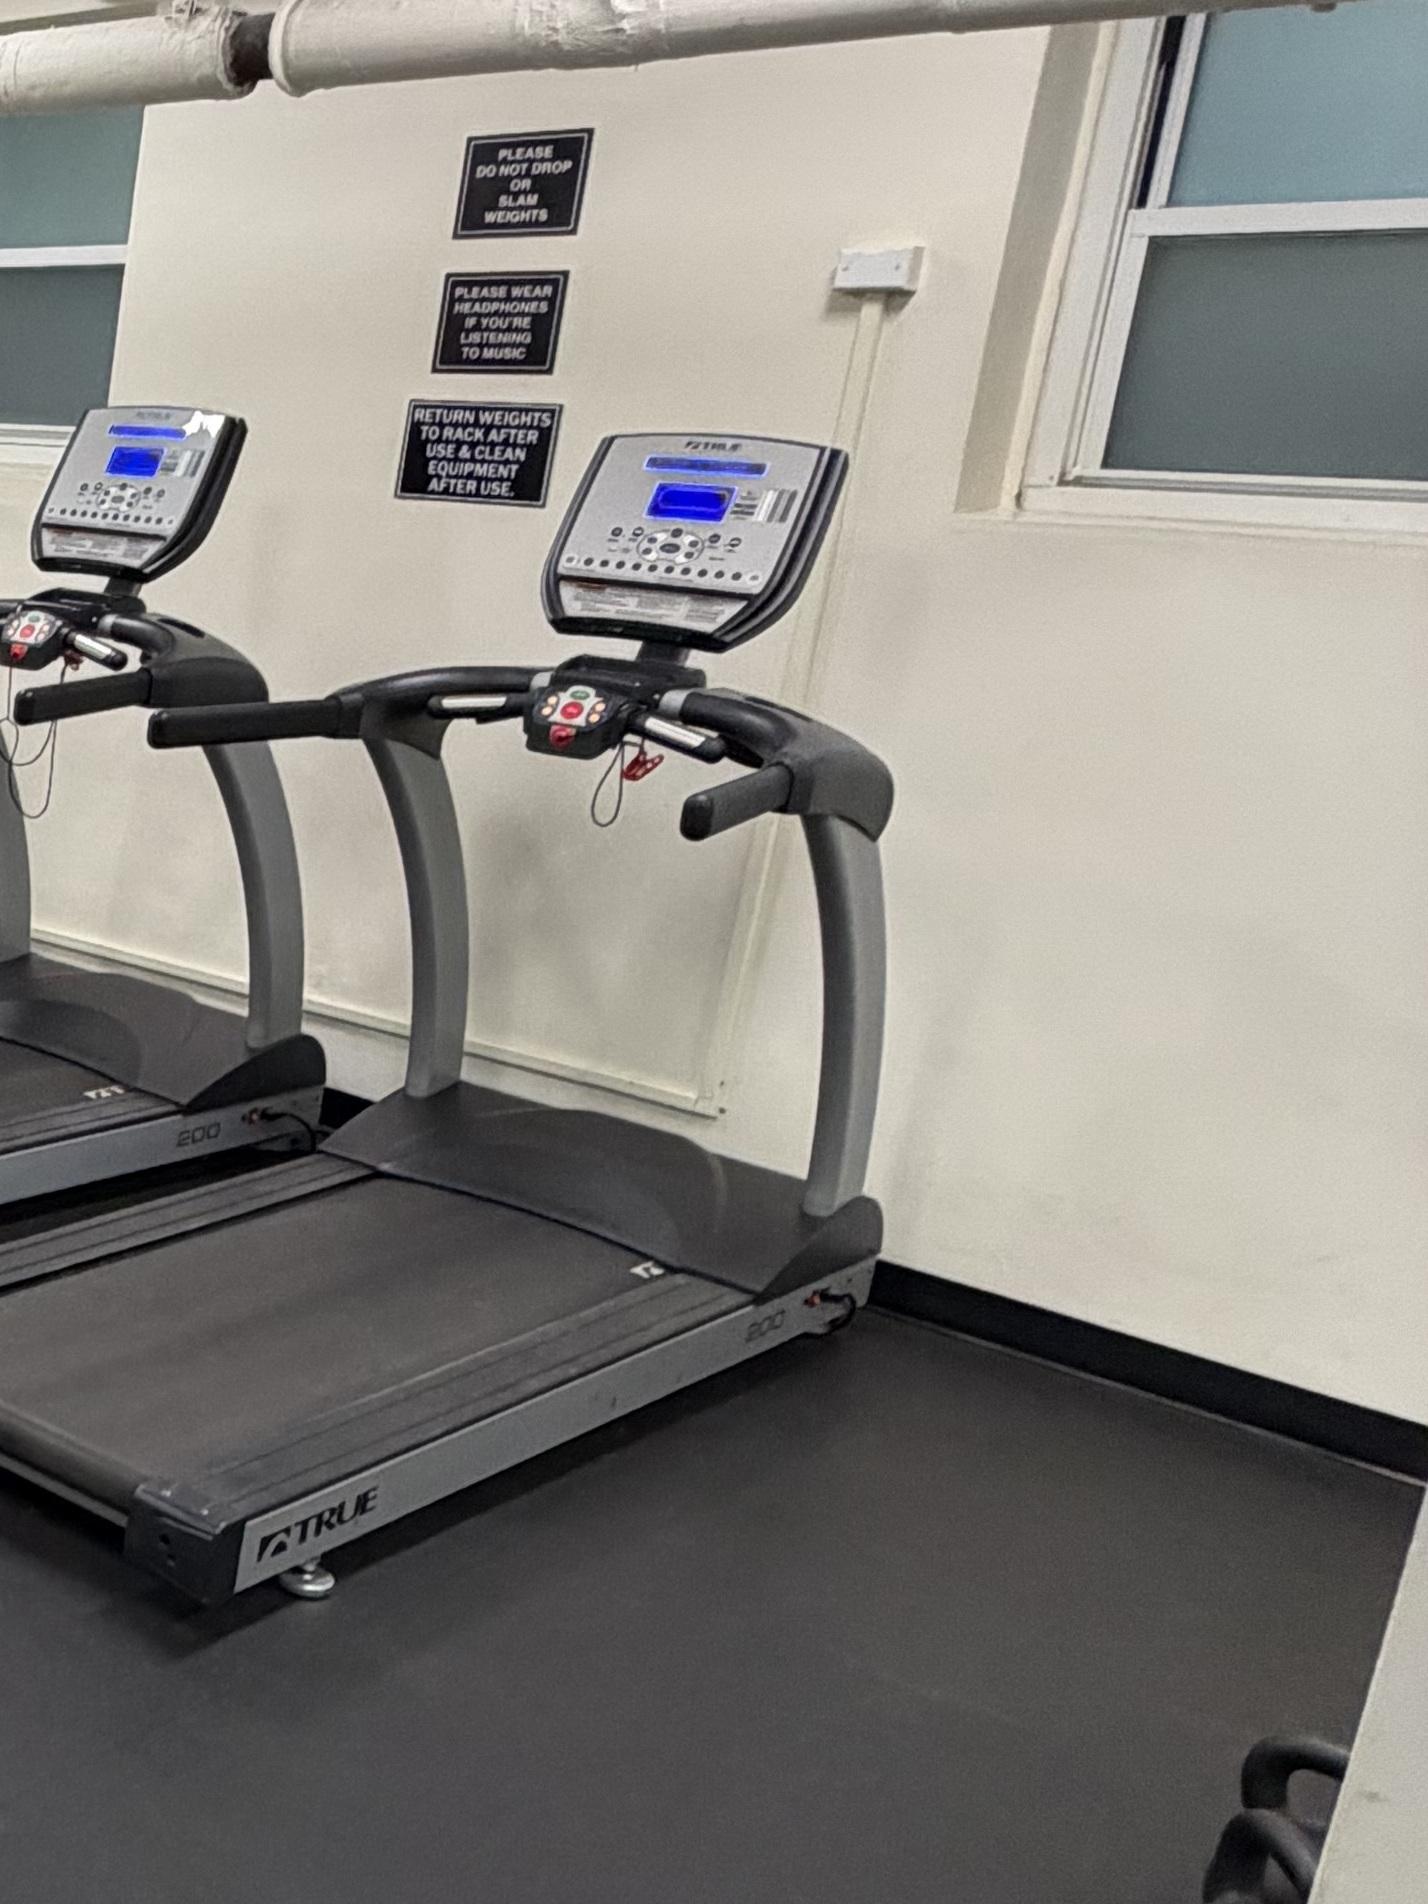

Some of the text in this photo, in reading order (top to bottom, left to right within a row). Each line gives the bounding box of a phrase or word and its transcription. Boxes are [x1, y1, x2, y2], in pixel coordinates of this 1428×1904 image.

[498, 145, 554, 162] PLEASE
[476, 160, 573, 178] DO NOT DROP
[510, 178, 532, 192] OR
[498, 193, 539, 208] SLAM
[484, 208, 548, 224] WEIGHTS
[454, 285, 553, 299] PLEASE WEAR
[453, 301, 548, 314] HEADPHONES
[464, 316, 532, 329] IF YOU'RE
[460, 331, 532, 345] LISTENING
[461, 347, 526, 360] TO MUSIC
[413, 408, 551, 428] RETURN WEIGHTS
[420, 425, 539, 445] TO RACK AFTER
[426, 443, 526, 462] USE & CLEAN
[427, 460, 519, 480] EQUIPMENT
[427, 477, 515, 497] AFTER USE.
[177, 1121, 221, 1148] 200
[295, 1485, 380, 1545] TRUE
